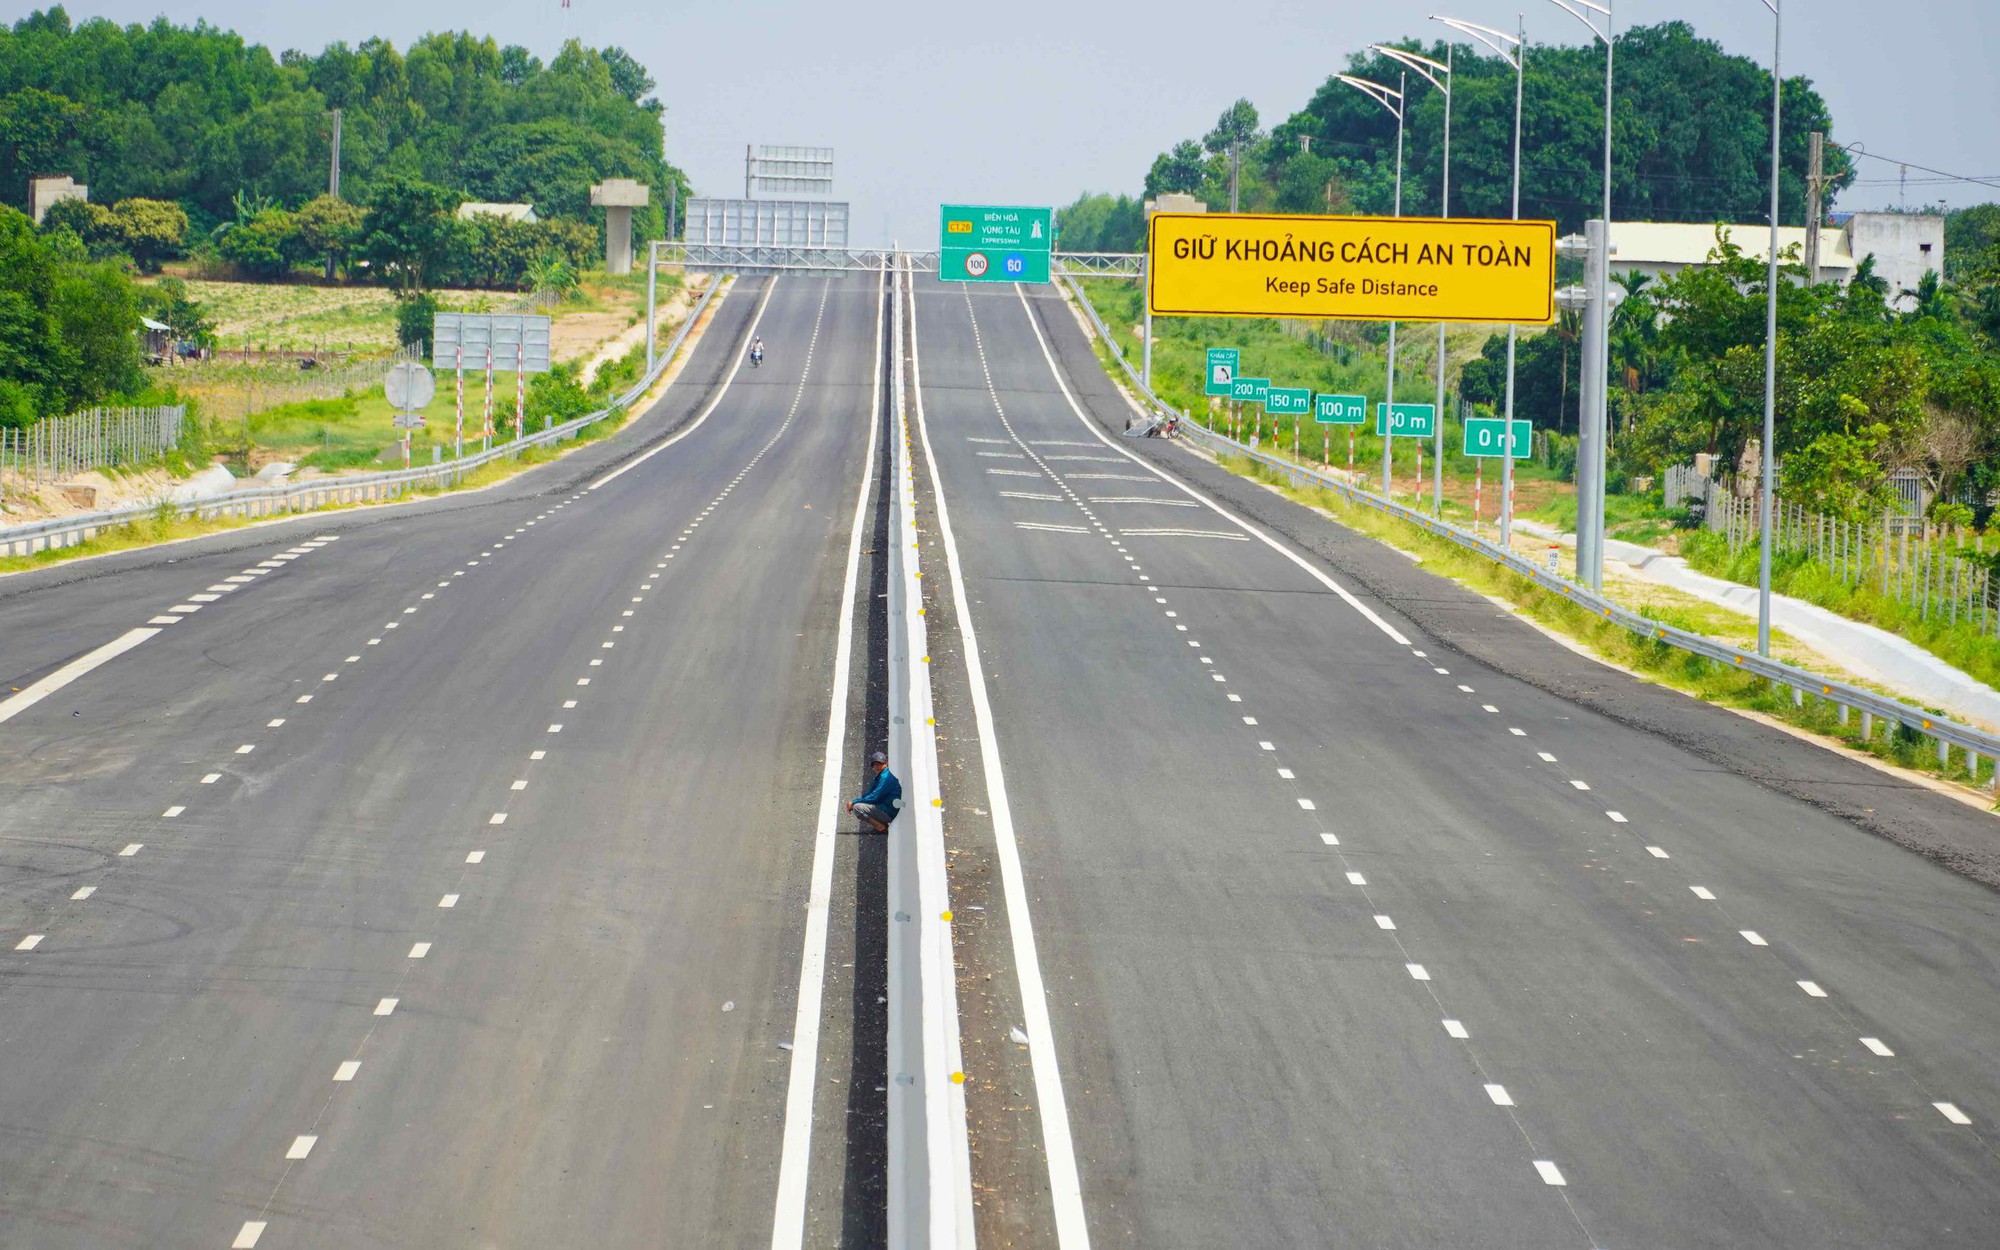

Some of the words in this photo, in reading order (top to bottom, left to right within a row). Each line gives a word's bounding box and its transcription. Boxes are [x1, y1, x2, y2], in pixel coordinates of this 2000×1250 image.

[1174, 234, 1217, 259] GIỮ
[1226, 233, 1334, 262] KHOẢNG
[1341, 237, 1408, 264] CÁCH
[1417, 244, 1453, 265] AN
[1462, 240, 1531, 267] TOÀN
[970, 260, 985, 269] 100
[1007, 259, 1022, 272] 60
[1266, 277, 1310, 297] Keep
[1317, 278, 1355, 294] Safe
[1362, 279, 1438, 296] Distance
[1235, 384, 1253, 395] 200
[1256, 387, 1266, 395] m
[1270, 394, 1289, 407] 150
[1294, 398, 1306, 407] m
[1321, 402, 1343, 416] 100
[1348, 406, 1361, 417] m
[1410, 417, 1425, 428] m
[1479, 429, 1490, 446] 0
